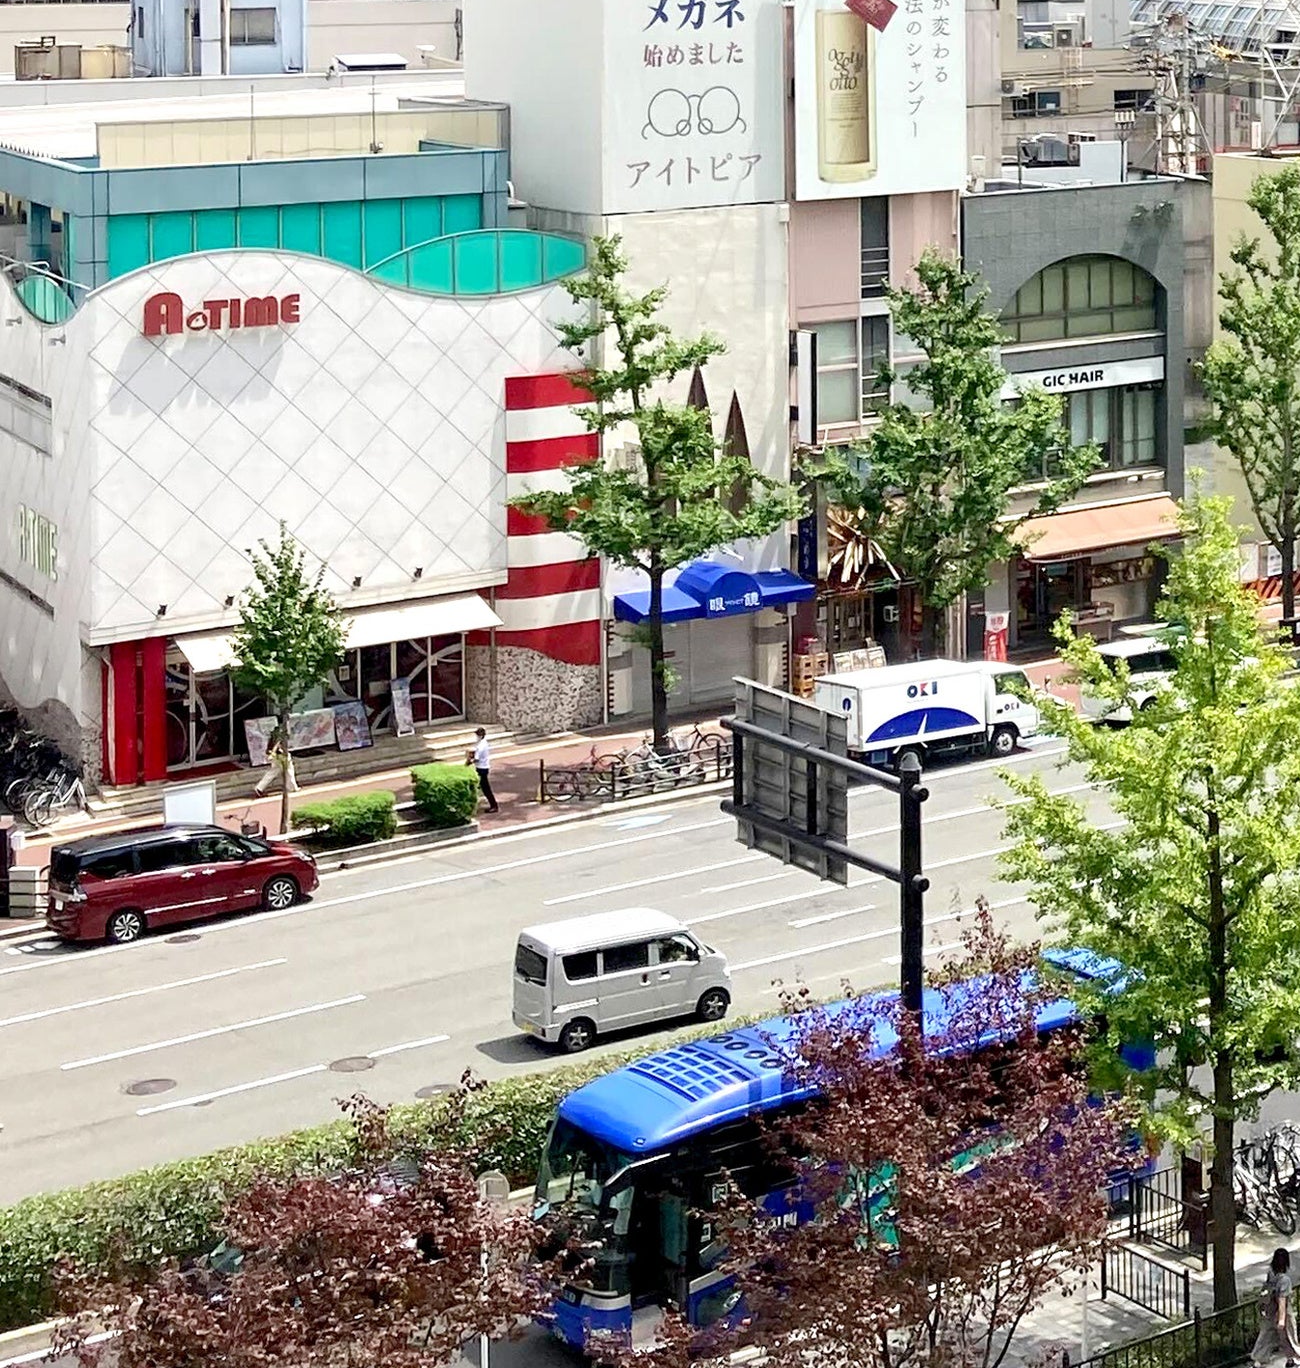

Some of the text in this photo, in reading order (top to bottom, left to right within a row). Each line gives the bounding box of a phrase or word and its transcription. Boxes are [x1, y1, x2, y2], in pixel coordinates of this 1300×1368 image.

[642, 41, 745, 68] 始めました
[625, 152, 764, 189] アイトピア
[1042, 369, 1104, 387] GIC HAIR
[906, 680, 939, 699] OKI
